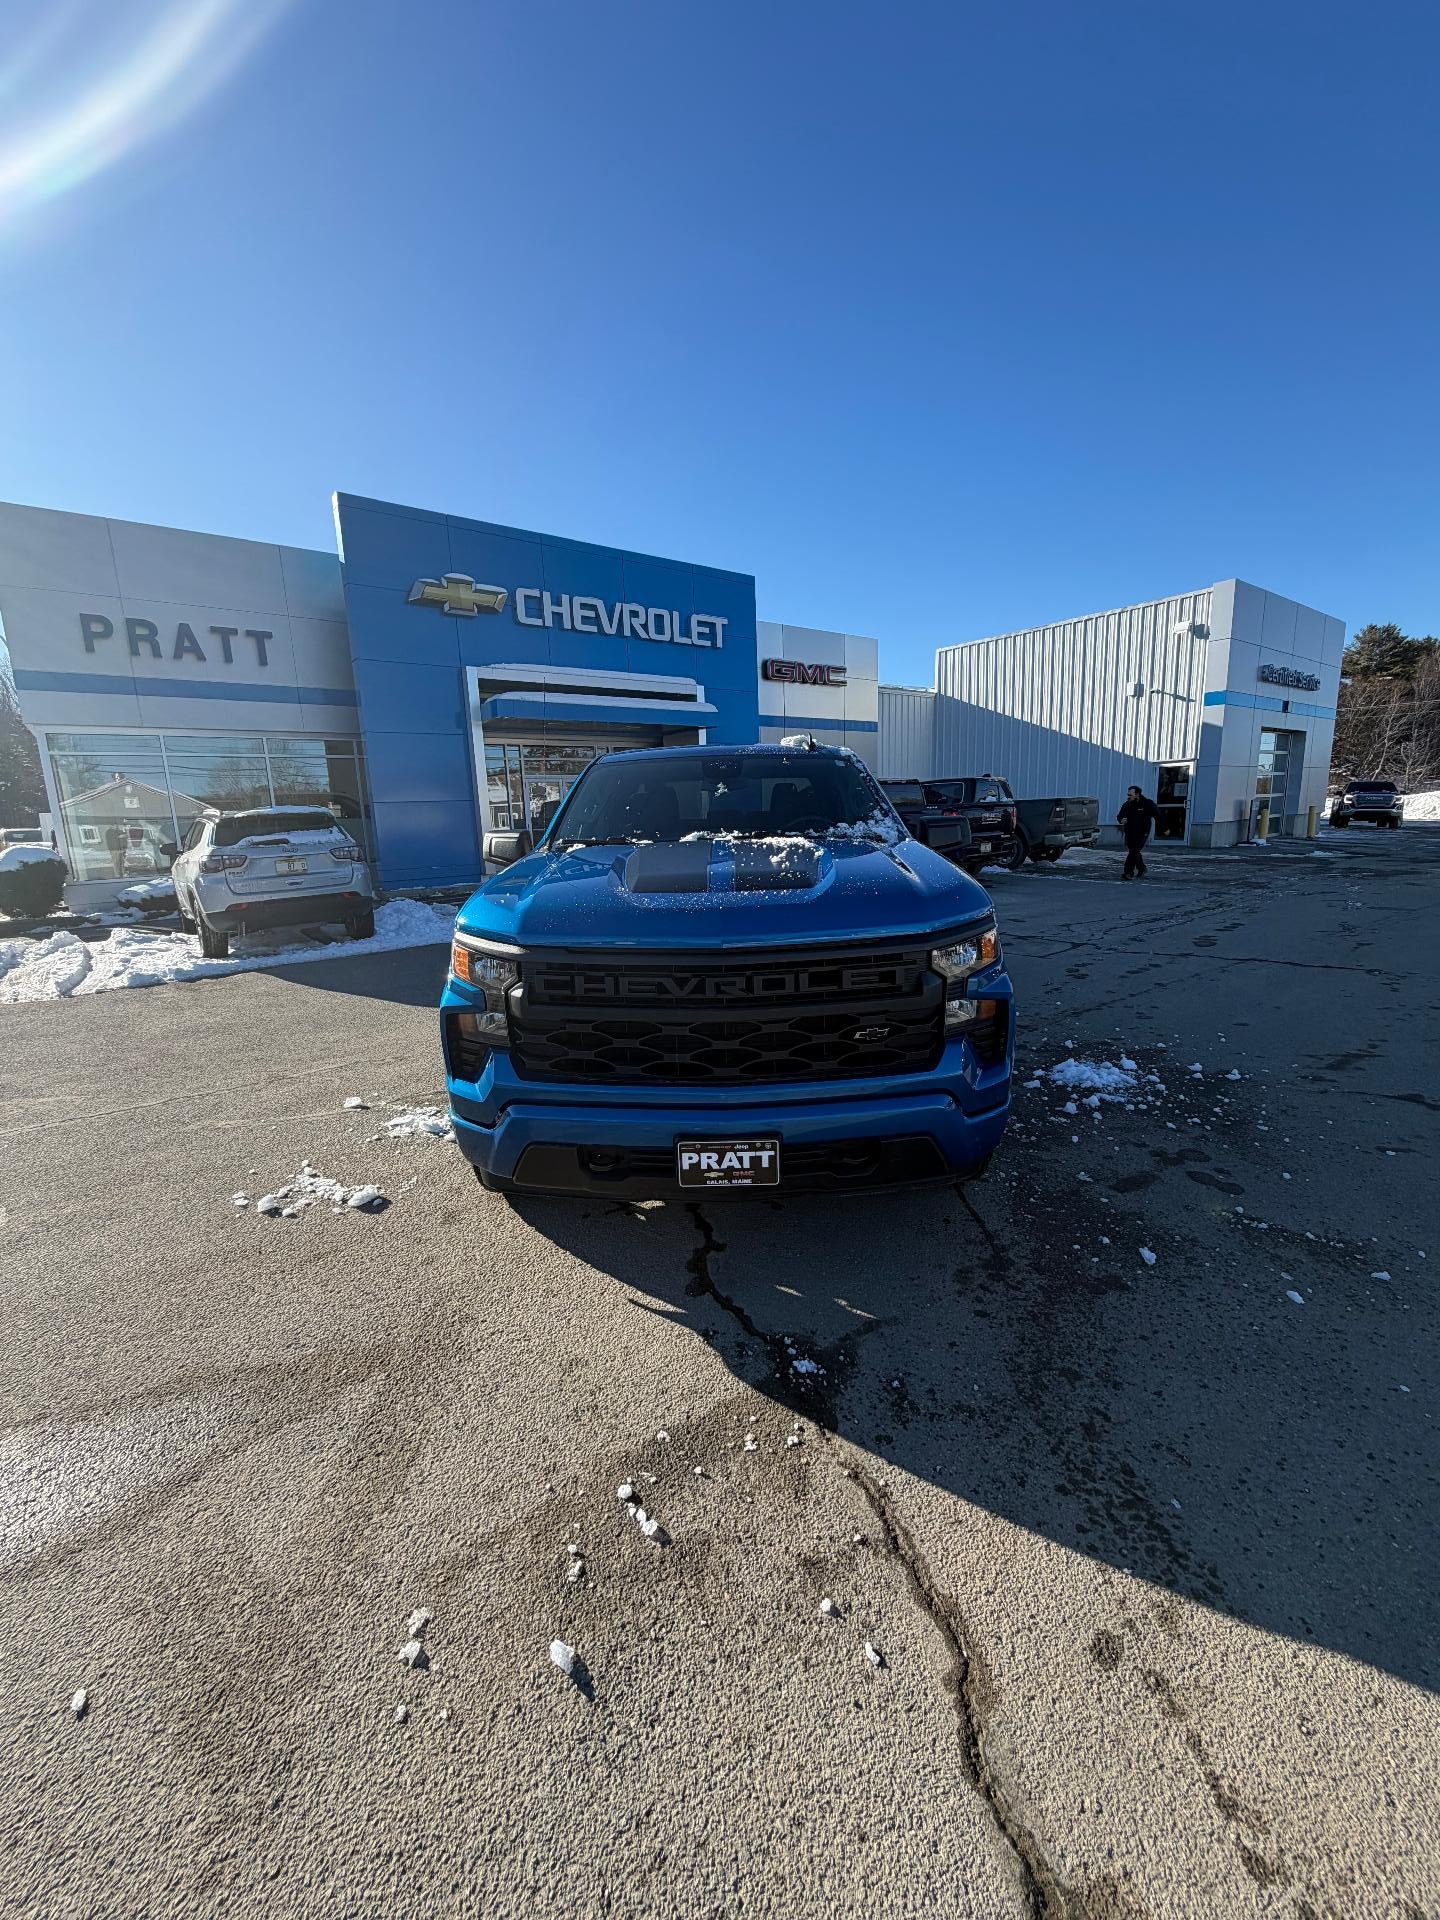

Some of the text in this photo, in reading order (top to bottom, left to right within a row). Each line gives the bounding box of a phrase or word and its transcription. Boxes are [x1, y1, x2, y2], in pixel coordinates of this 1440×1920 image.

[515, 587, 729, 649] CHEVROLET
[79, 612, 274, 667] PRATT
[763, 658, 848, 687] GMC
[1267, 664, 1298, 686] Certified
[534, 964, 911, 998] CHEVROLET
[681, 1151, 775, 1170] PRATT
